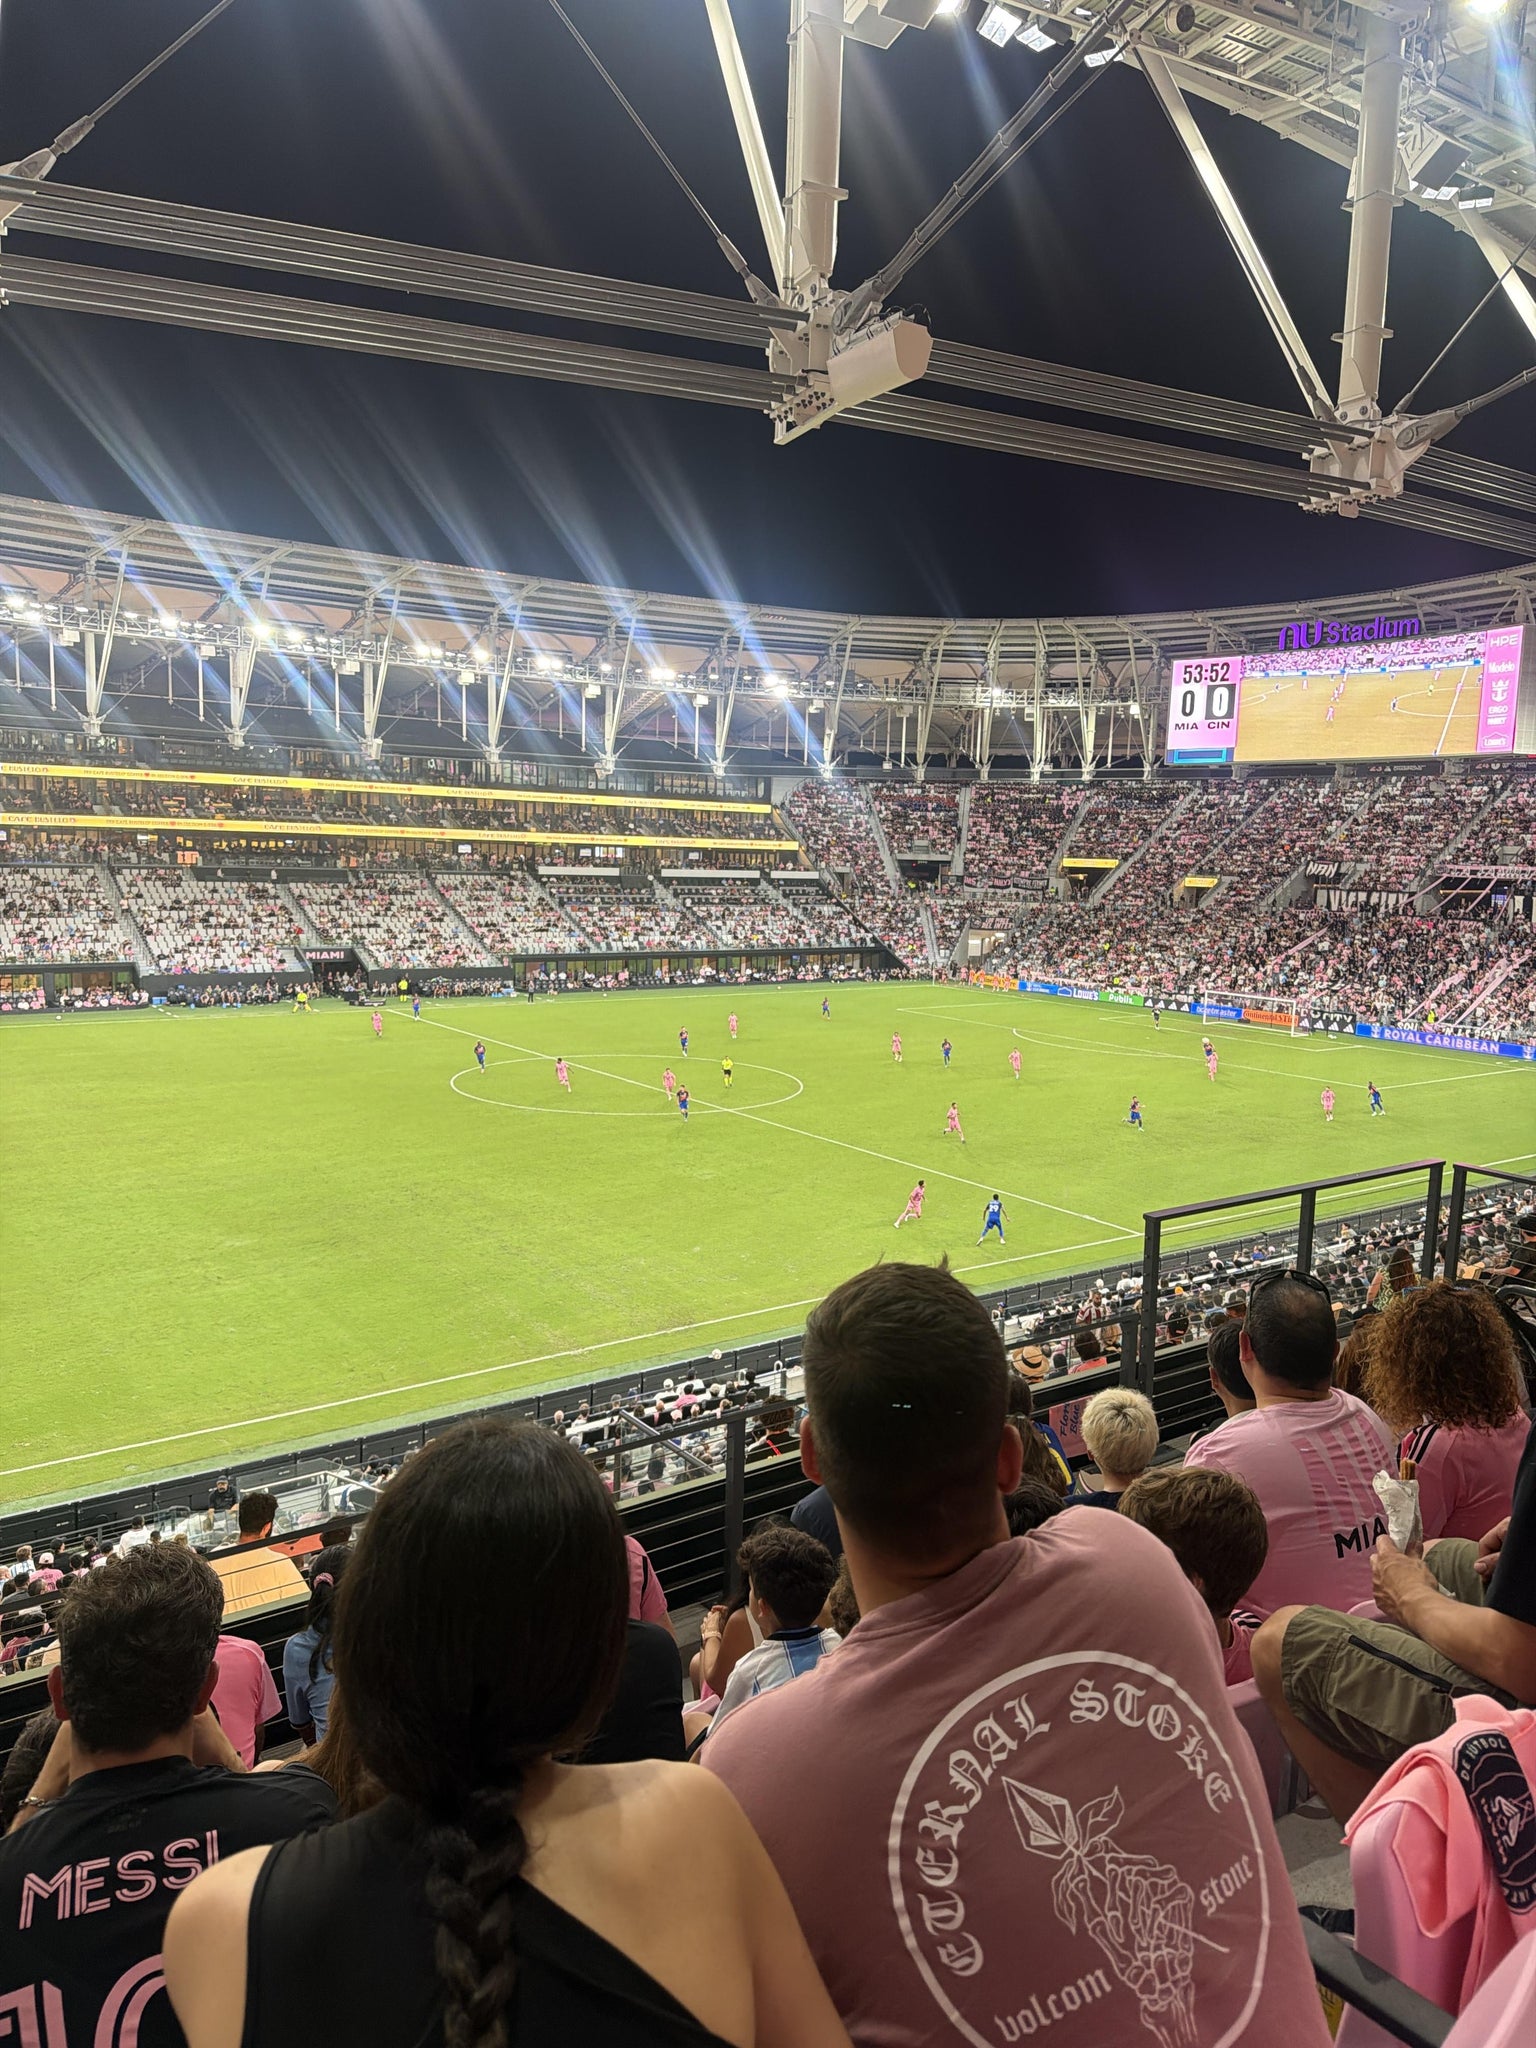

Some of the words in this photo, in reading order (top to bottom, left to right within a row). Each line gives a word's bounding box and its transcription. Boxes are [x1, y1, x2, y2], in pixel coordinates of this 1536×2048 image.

[1326, 615, 1420, 645] Stadium
[1490, 634, 1518, 648] HPE
[1183, 662, 1230, 684] 53:52
[1487, 661, 1515, 674] Modelo
[1181, 690, 1195, 717] 0
[1212, 686, 1229, 717] 0
[1174, 722, 1199, 731] MIA
[1207, 721, 1230, 730] CIN
[305, 951, 345, 960] MIAMI
[1073, 987, 1099, 1001] LOWE'S
[1384, 1028, 1421, 1044] ROYAL
[1425, 1034, 1500, 1054] CARIBBEAN
[1069, 1403, 1081, 1435] Blue
[1460, 1759, 1471, 1782] DE
[915, 1693, 1050, 1977] ETERNAL
[19, 1829, 219, 1930] MESSI
[1200, 1854, 1254, 1917] stone
[994, 1968, 1112, 2042] volcom
